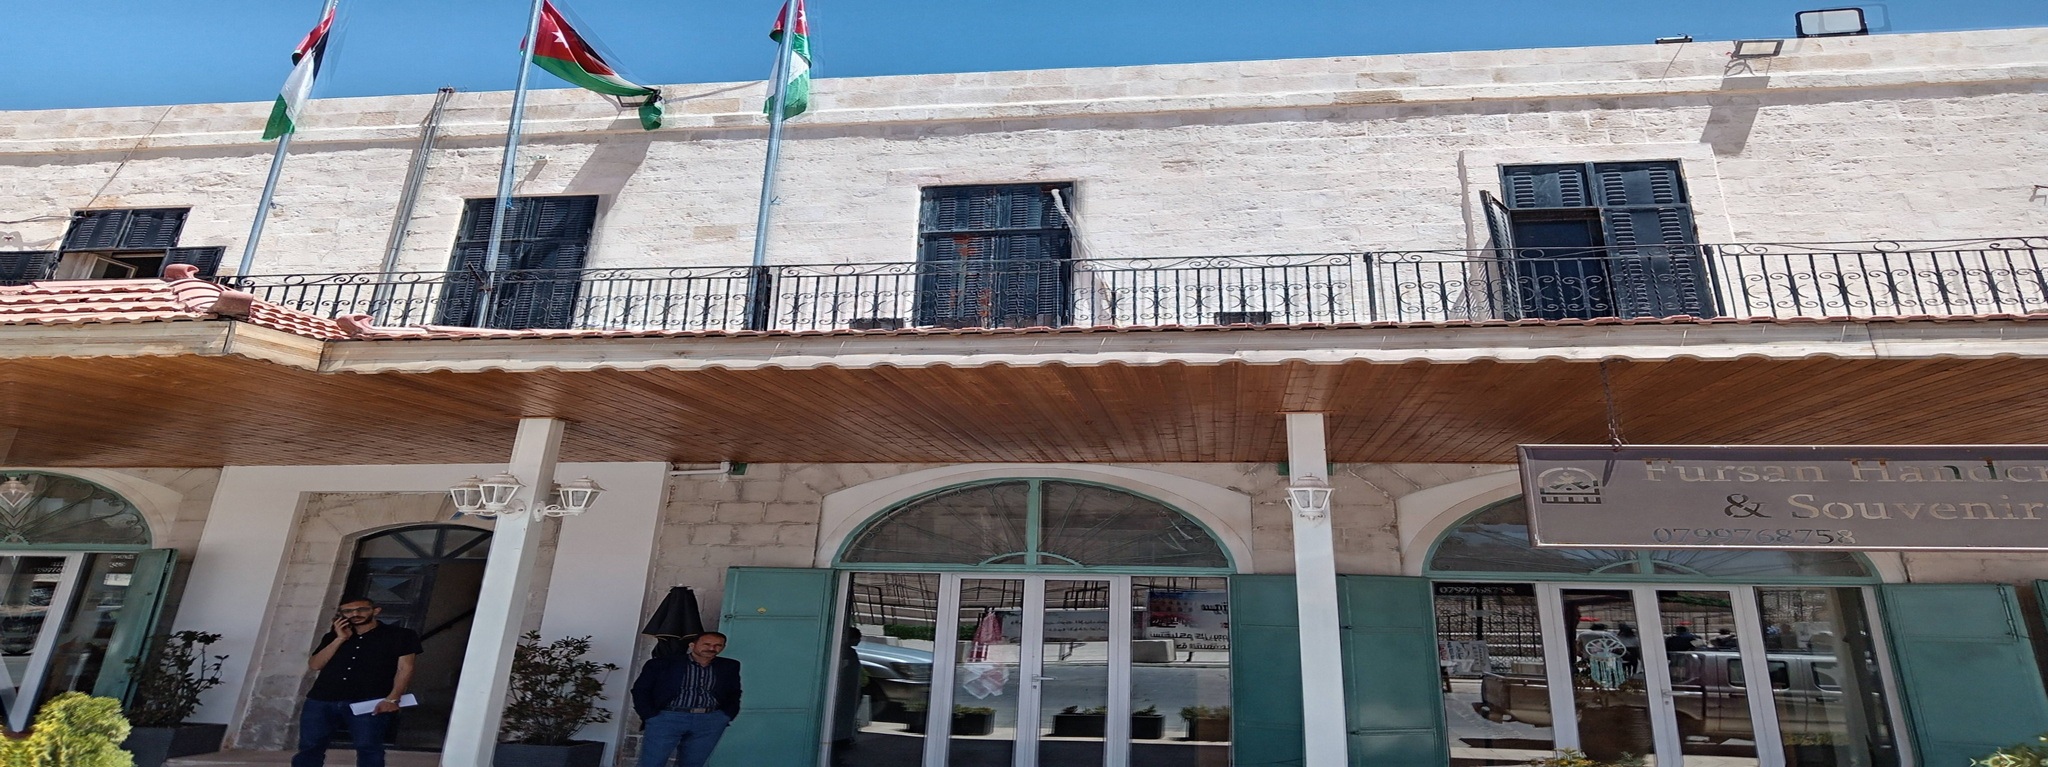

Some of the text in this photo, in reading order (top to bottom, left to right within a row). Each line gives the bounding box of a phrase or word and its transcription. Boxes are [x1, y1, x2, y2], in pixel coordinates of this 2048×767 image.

[1642, 457, 1829, 483] Fursan
[1724, 493, 2048, 520] & Souvenir
[1653, 527, 1857, 545] 0799768758
